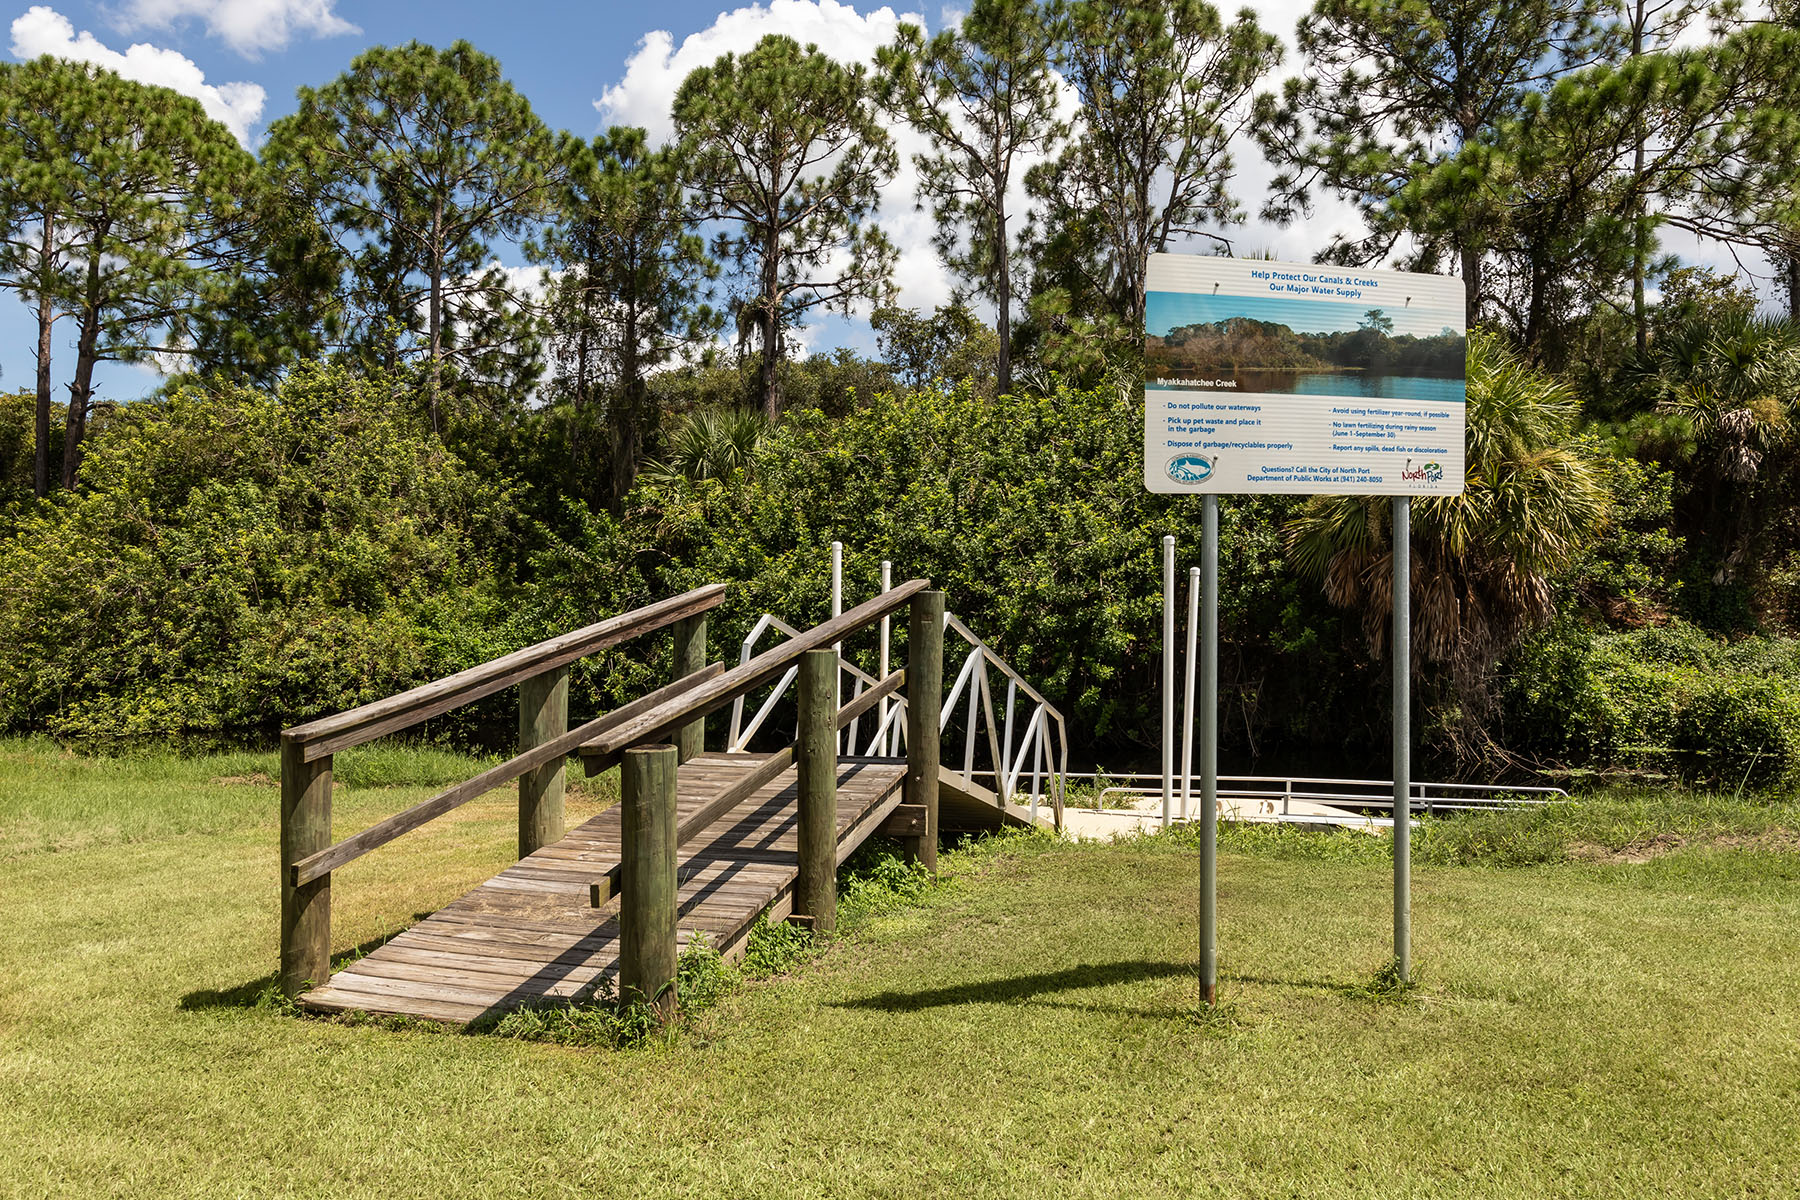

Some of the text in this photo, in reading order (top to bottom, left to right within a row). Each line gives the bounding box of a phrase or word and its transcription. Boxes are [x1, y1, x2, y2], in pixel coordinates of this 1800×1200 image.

[1251, 271, 1378, 287] Help Protect Our Canals & Creeks
[1269, 283, 1361, 298] Our Major Water Supply
[1157, 378, 1214, 387] Myakkahatchee
